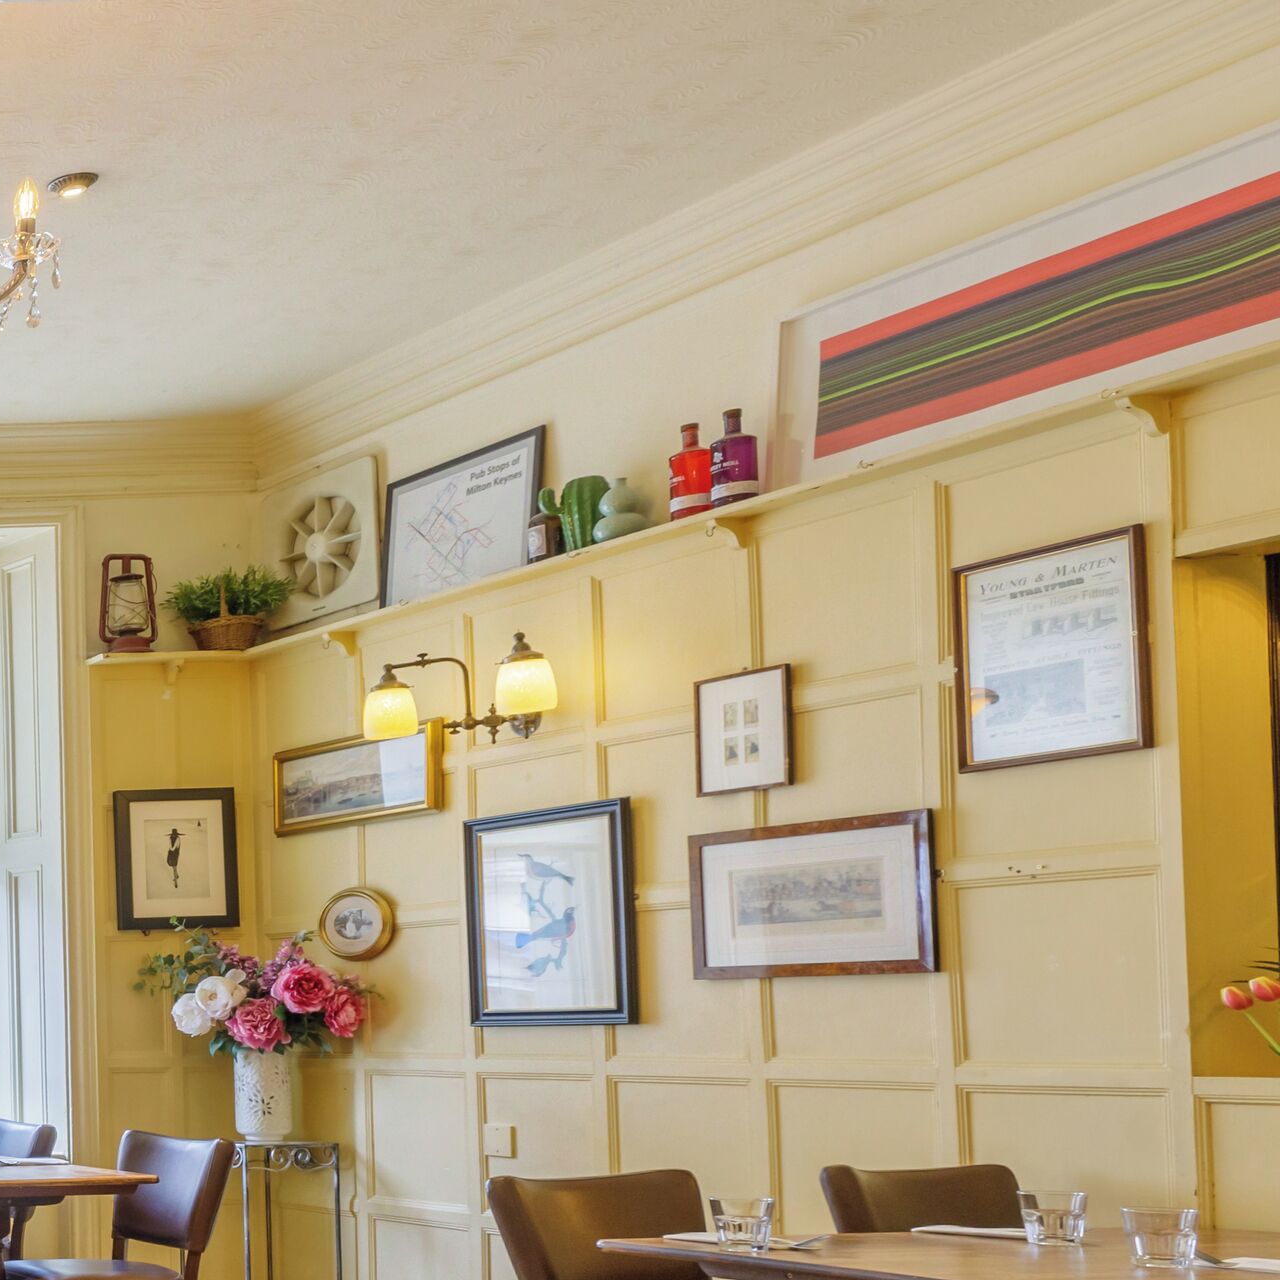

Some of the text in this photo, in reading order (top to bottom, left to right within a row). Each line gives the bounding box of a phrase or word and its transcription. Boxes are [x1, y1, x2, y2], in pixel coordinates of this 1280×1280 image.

[469, 455, 522, 481] Pub Stops of
[466, 470, 523, 496] Milton Keynes
[978, 556, 1118, 596] YOUNG & MARTEN
[1008, 577, 1085, 600] STRATFORD
